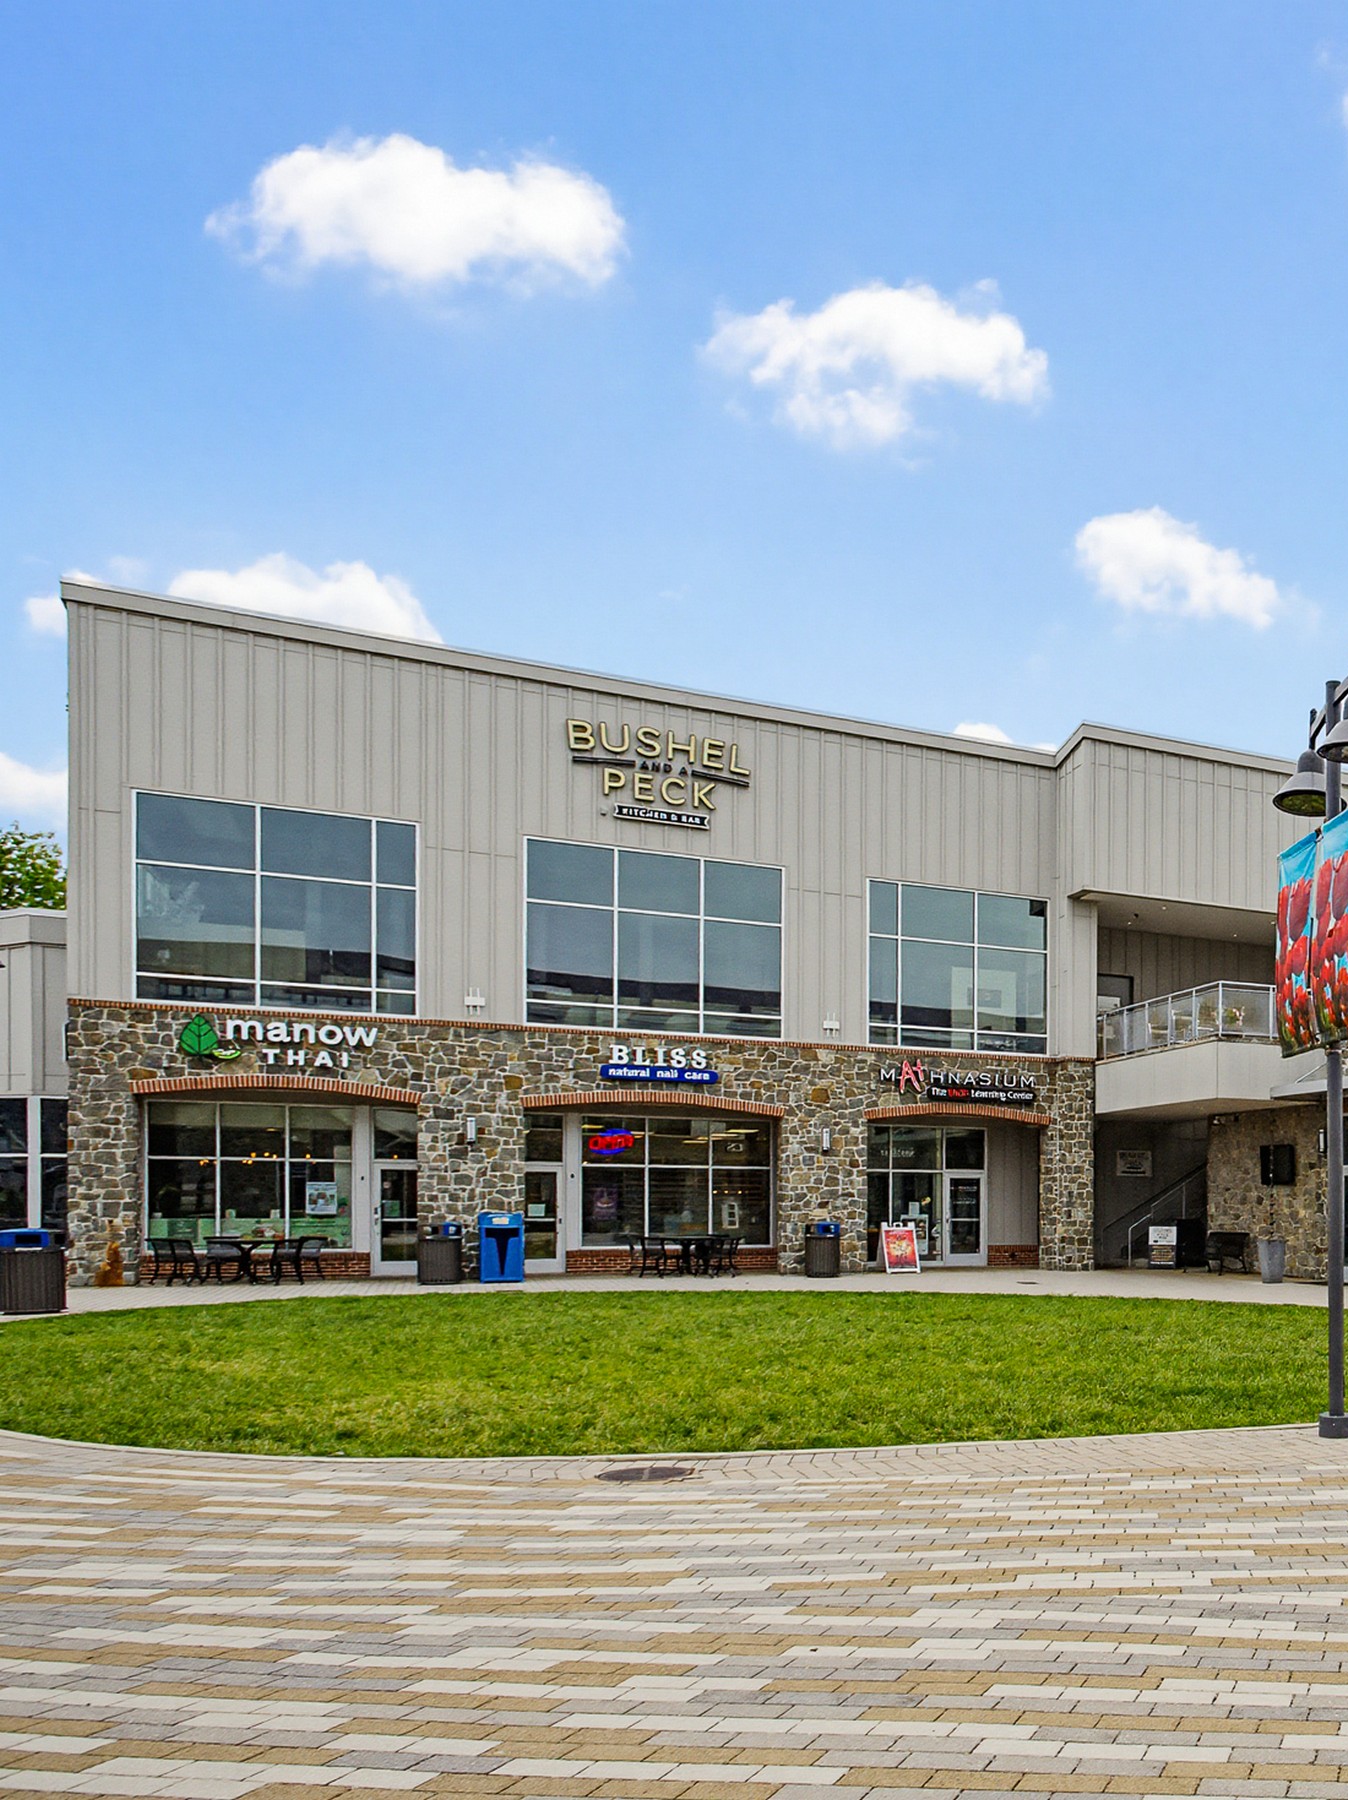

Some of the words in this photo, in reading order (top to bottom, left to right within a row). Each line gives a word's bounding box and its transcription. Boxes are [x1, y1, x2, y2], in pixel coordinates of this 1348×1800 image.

[566, 718, 750, 776] BUSHEL
[639, 760, 673, 774] AND
[678, 766, 689, 777] A
[603, 767, 717, 810] PECK
[622, 808, 667, 820] KITCHEN
[681, 815, 701, 824] BAR
[226, 1018, 378, 1047] manow
[262, 1048, 350, 1068] THAI
[608, 1044, 707, 1069] BLISS
[608, 1067, 650, 1077] natural
[656, 1069, 678, 1078] nail
[684, 1072, 710, 1080] care
[931, 1086, 947, 1097] The
[971, 1089, 1006, 1101] Learning
[1007, 1091, 1033, 1100] Center
